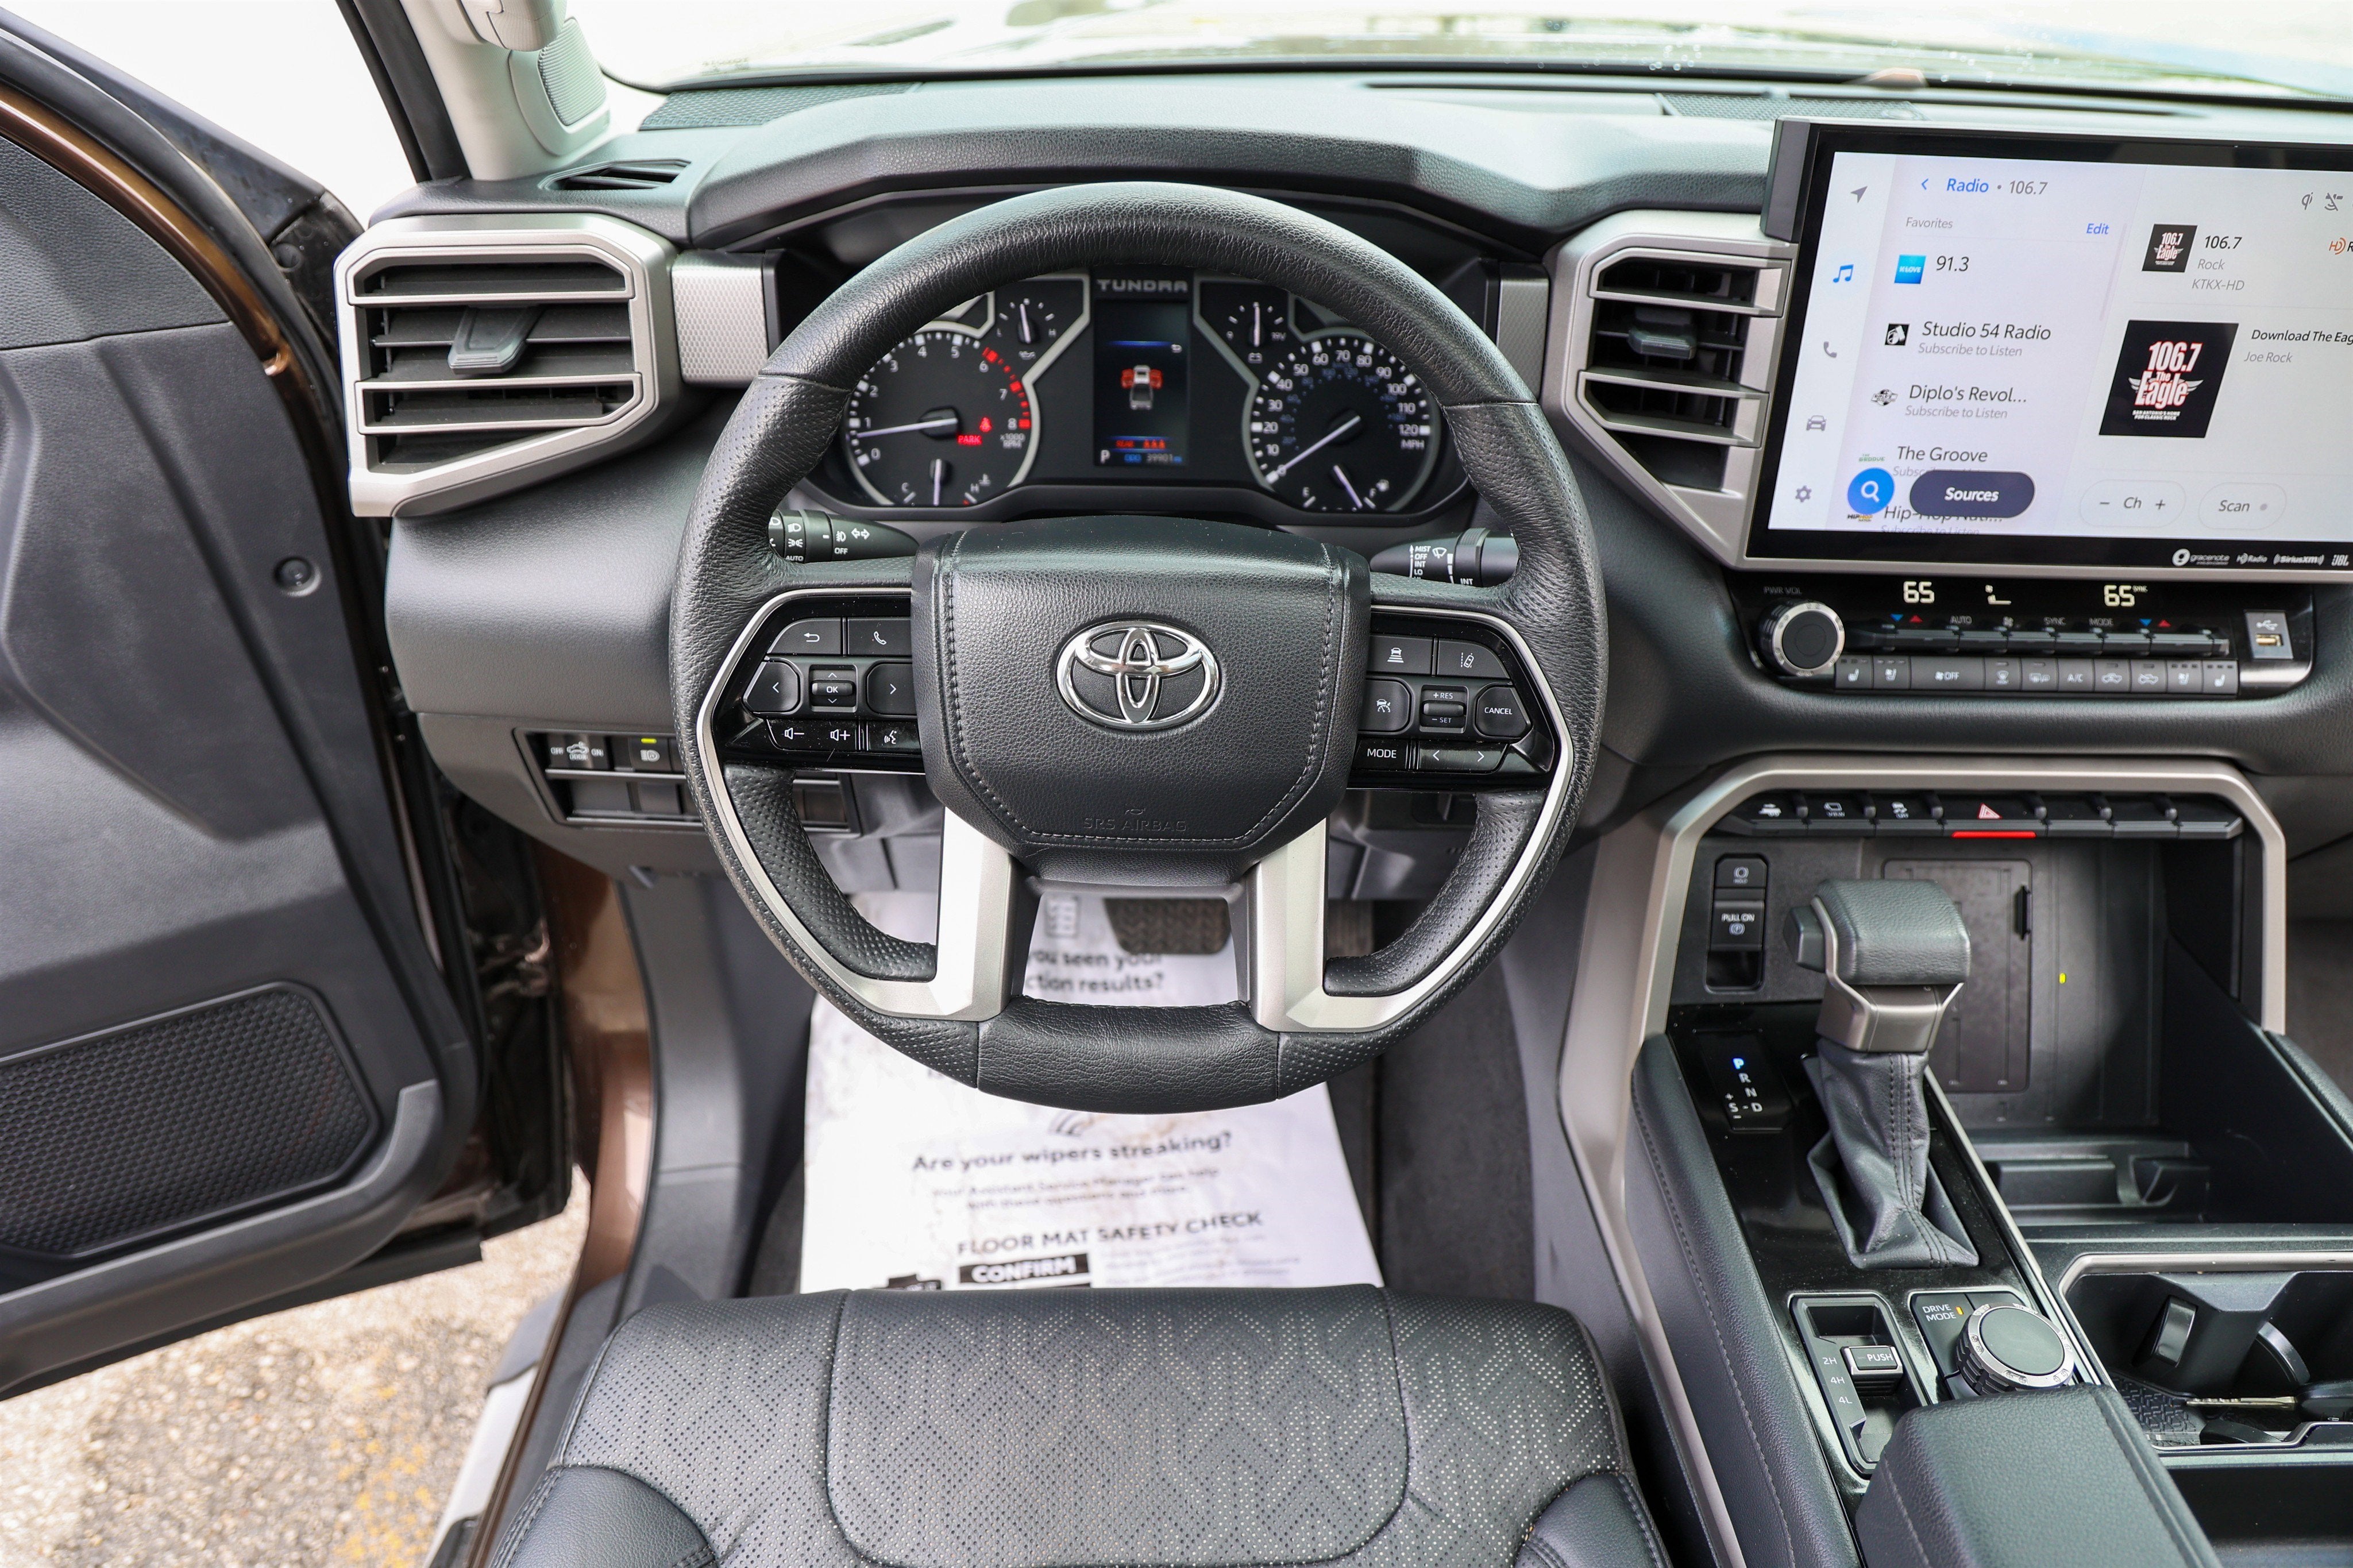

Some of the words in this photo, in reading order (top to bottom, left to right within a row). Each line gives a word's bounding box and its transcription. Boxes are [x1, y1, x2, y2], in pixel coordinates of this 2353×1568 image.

[1946, 178, 1989, 192] Radio
[2009, 180, 2048, 195] 106.7
[1905, 217, 1953, 229] Favorites
[2086, 223, 2109, 234] Edit
[2162, 233, 2184, 245] 106.7
[2205, 235, 2243, 249] 106.7
[2156, 245, 2178, 260] Eagle
[1936, 256, 1969, 272] 91.3
[2197, 258, 2225, 270] Rock
[1097, 279, 1188, 293] TUNDRA
[2192, 279, 2245, 291] KTKX-HD
[1048, 328, 1057, 338] H
[1922, 320, 1976, 338] Studio
[1980, 323, 1999, 338] 54
[2004, 324, 2051, 339] Radio
[2251, 330, 2310, 341] Download
[2313, 331, 2332, 342] The
[917, 346, 927, 358] 4
[951, 346, 960, 358] 5
[1918, 342, 1973, 355] Subscribe
[1976, 346, 1987, 355] to
[1991, 345, 2022, 357] Listen
[1312, 353, 1329, 365] 60
[1336, 350, 1351, 362] 70
[1356, 354, 1372, 368] 80
[2147, 341, 2202, 372] 106.7
[2244, 352, 2263, 362] Joe
[2266, 352, 2293, 363] Rock
[890, 360, 898, 373] 3
[979, 360, 989, 373] 6
[1293, 364, 1309, 376] 50
[1375, 366, 1392, 379] 90
[2156, 371, 2171, 381] The
[870, 385, 878, 397] 2
[1276, 379, 1293, 391] 40
[1387, 383, 1407, 396] 100
[2134, 370, 2188, 410] Eagle
[999, 388, 1008, 401] 7
[1910, 385, 1964, 403] Diplo's
[1267, 399, 1283, 412] 30
[1397, 402, 1416, 415] 110
[1905, 405, 1959, 417] Subscribe
[1962, 408, 1973, 418] to
[1976, 407, 2007, 419] Listen
[865, 417, 871, 428] 1
[1008, 418, 1017, 430] 8
[1263, 422, 1279, 434] 20
[1398, 424, 1419, 437] 120
[957, 435, 982, 446] PARK
[1401, 439, 1425, 450] MPH
[871, 449, 881, 460] 0
[1266, 443, 1279, 457] 10
[1897, 446, 1924, 460] The
[1930, 447, 1988, 462] Groove
[1100, 450, 1110, 464] P
[901, 482, 909, 493] C
[1302, 486, 1309, 497] E
[1945, 487, 1999, 502] Sources
[2124, 496, 2142, 509] Ch
[2218, 500, 2250, 512] Scan
[2331, 554, 2349, 566] JBL
[1764, 586, 1784, 594] PWR
[1903, 581, 1935, 603] 65
[2104, 585, 2135, 607] 65
[1950, 616, 1973, 624] AUTO
[2043, 617, 2066, 625] SYNC
[2089, 618, 2114, 626] MODE
[1944, 671, 1959, 680] OFF
[2067, 674, 2083, 682] A/C
[1484, 707, 1513, 715] CANCEL
[591, 748, 604, 756] ON
[1367, 748, 1397, 758] MODE
[1083, 818, 1116, 830] SRS
[1121, 819, 1187, 832] AIRBAG
[1722, 913, 1741, 922] PULL
[1741, 913, 1755, 922] ON
[1064, 952, 1108, 967] seen
[1079, 973, 1164, 992] results?
[1733, 1058, 1744, 1069] P
[1738, 1072, 1752, 1083] R
[1745, 1087, 1757, 1097] N
[1728, 1102, 1738, 1112] S
[1751, 1102, 1762, 1112] D
[912, 1154, 952, 1171] Are
[961, 1153, 1013, 1172] your
[1022, 1145, 1102, 1166] wipers
[1109, 1130, 1232, 1159] streaking?
[958, 1235, 1034, 1255] FLOOR
[1042, 1229, 1089, 1246] MAT
[1097, 1222, 1179, 1242] SAFETY
[1185, 1210, 1263, 1234] CHECK
[971, 1256, 1077, 1283] CONFIRM
[1922, 1304, 1951, 1314] DRIVE
[1926, 1312, 1957, 1322] MODE
